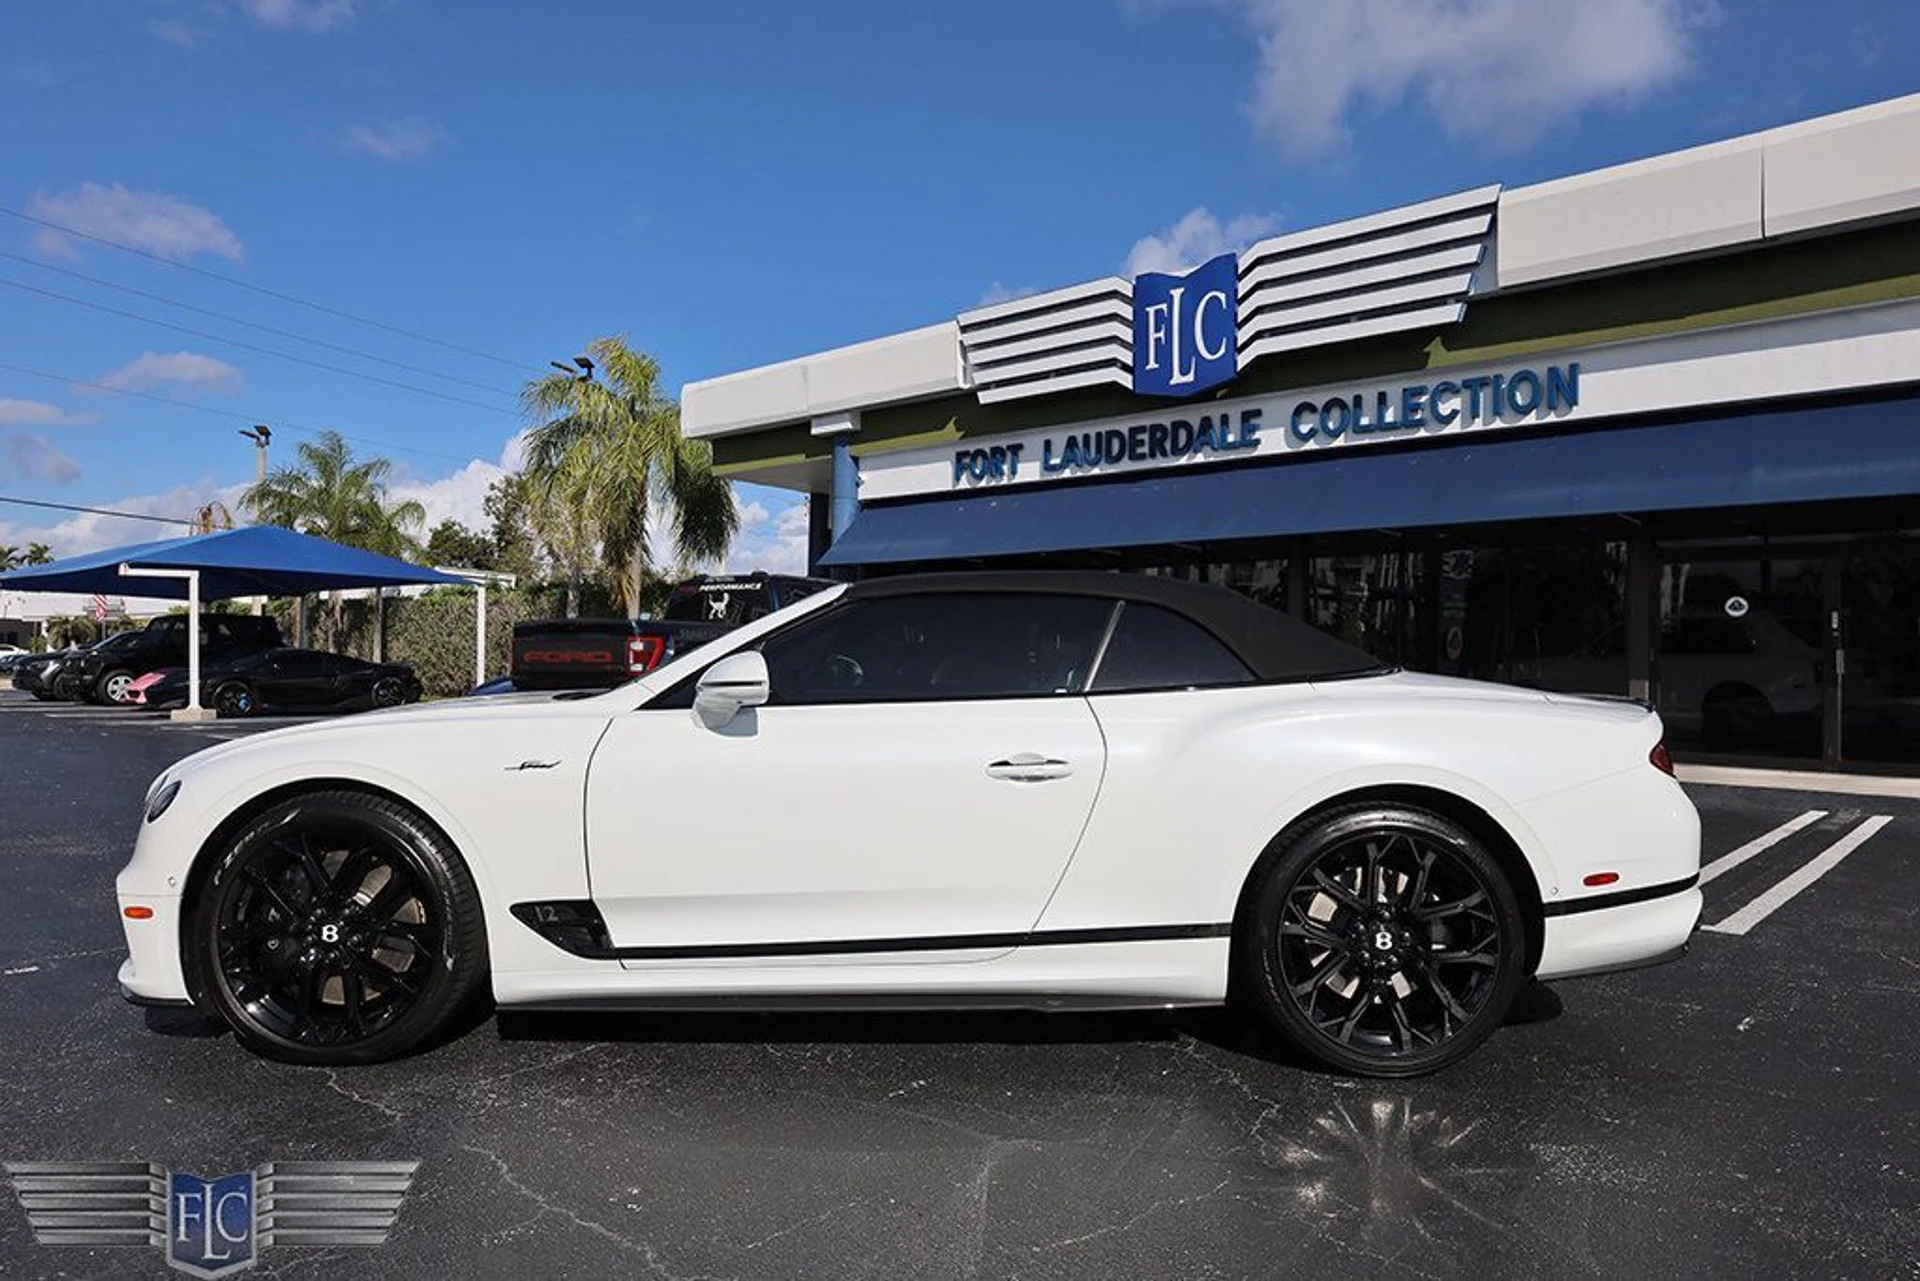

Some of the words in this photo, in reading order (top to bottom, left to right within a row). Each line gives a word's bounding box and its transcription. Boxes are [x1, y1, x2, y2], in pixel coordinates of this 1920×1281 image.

[1145, 287, 1227, 385] FLC
[953, 442, 1024, 484] FORT
[1043, 408, 1263, 473] LAUDERDALE
[1290, 362, 1580, 442] COLLECTION
[699, 582, 762, 591] PERFORMANCE
[523, 650, 612, 662] FORD
